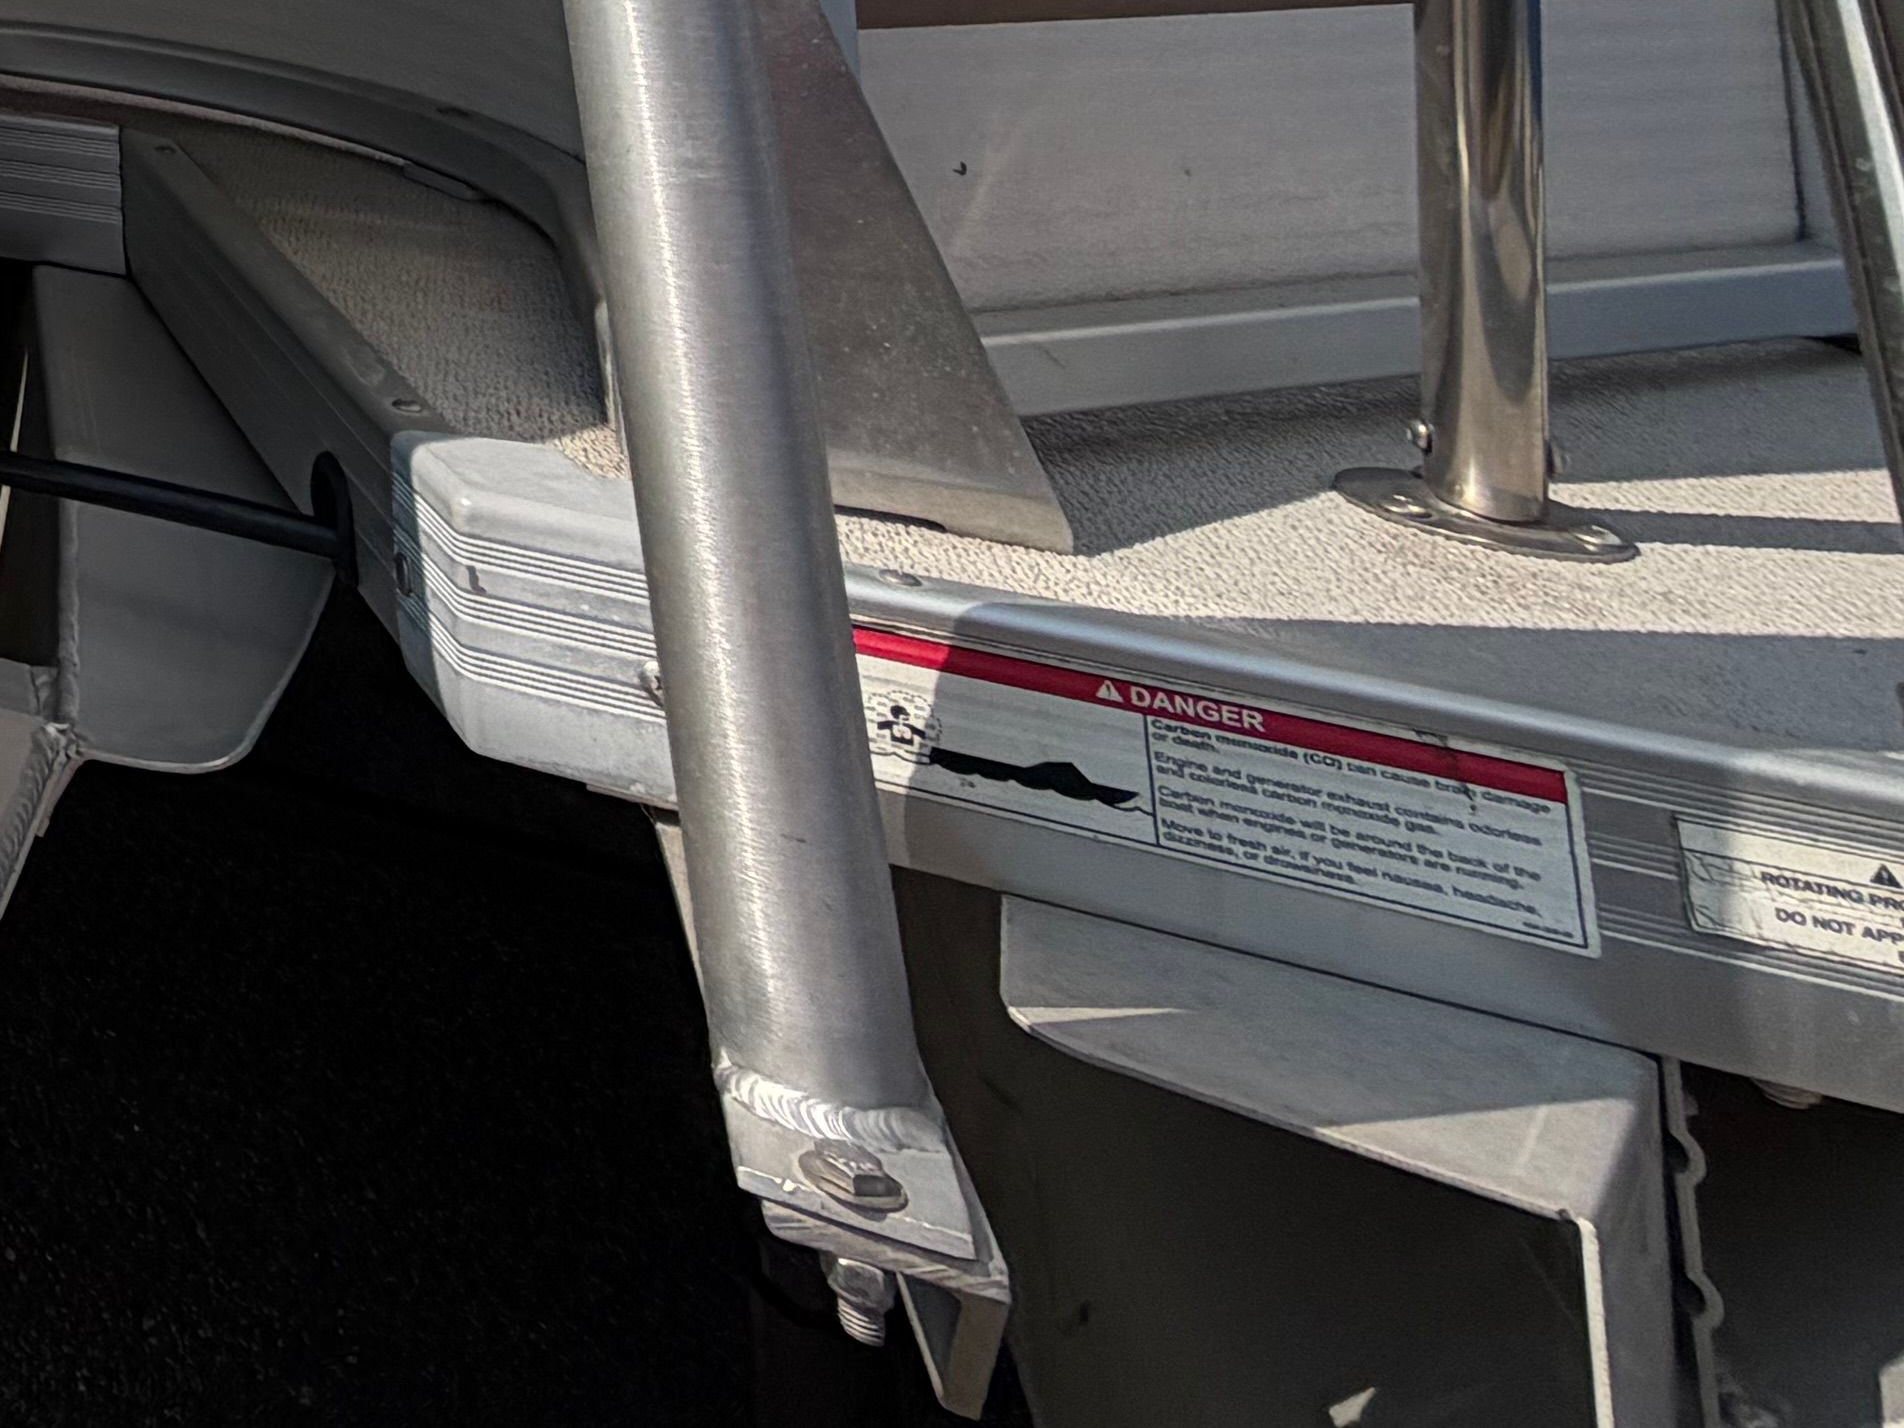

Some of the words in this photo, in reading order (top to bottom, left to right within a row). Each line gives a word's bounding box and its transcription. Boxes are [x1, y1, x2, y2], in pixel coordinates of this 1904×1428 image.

[1130, 685, 1266, 732] DANGER
[1761, 872, 1864, 904] ROTATING
[1775, 907, 1807, 926] DO
[1813, 916, 1856, 937] NOT
